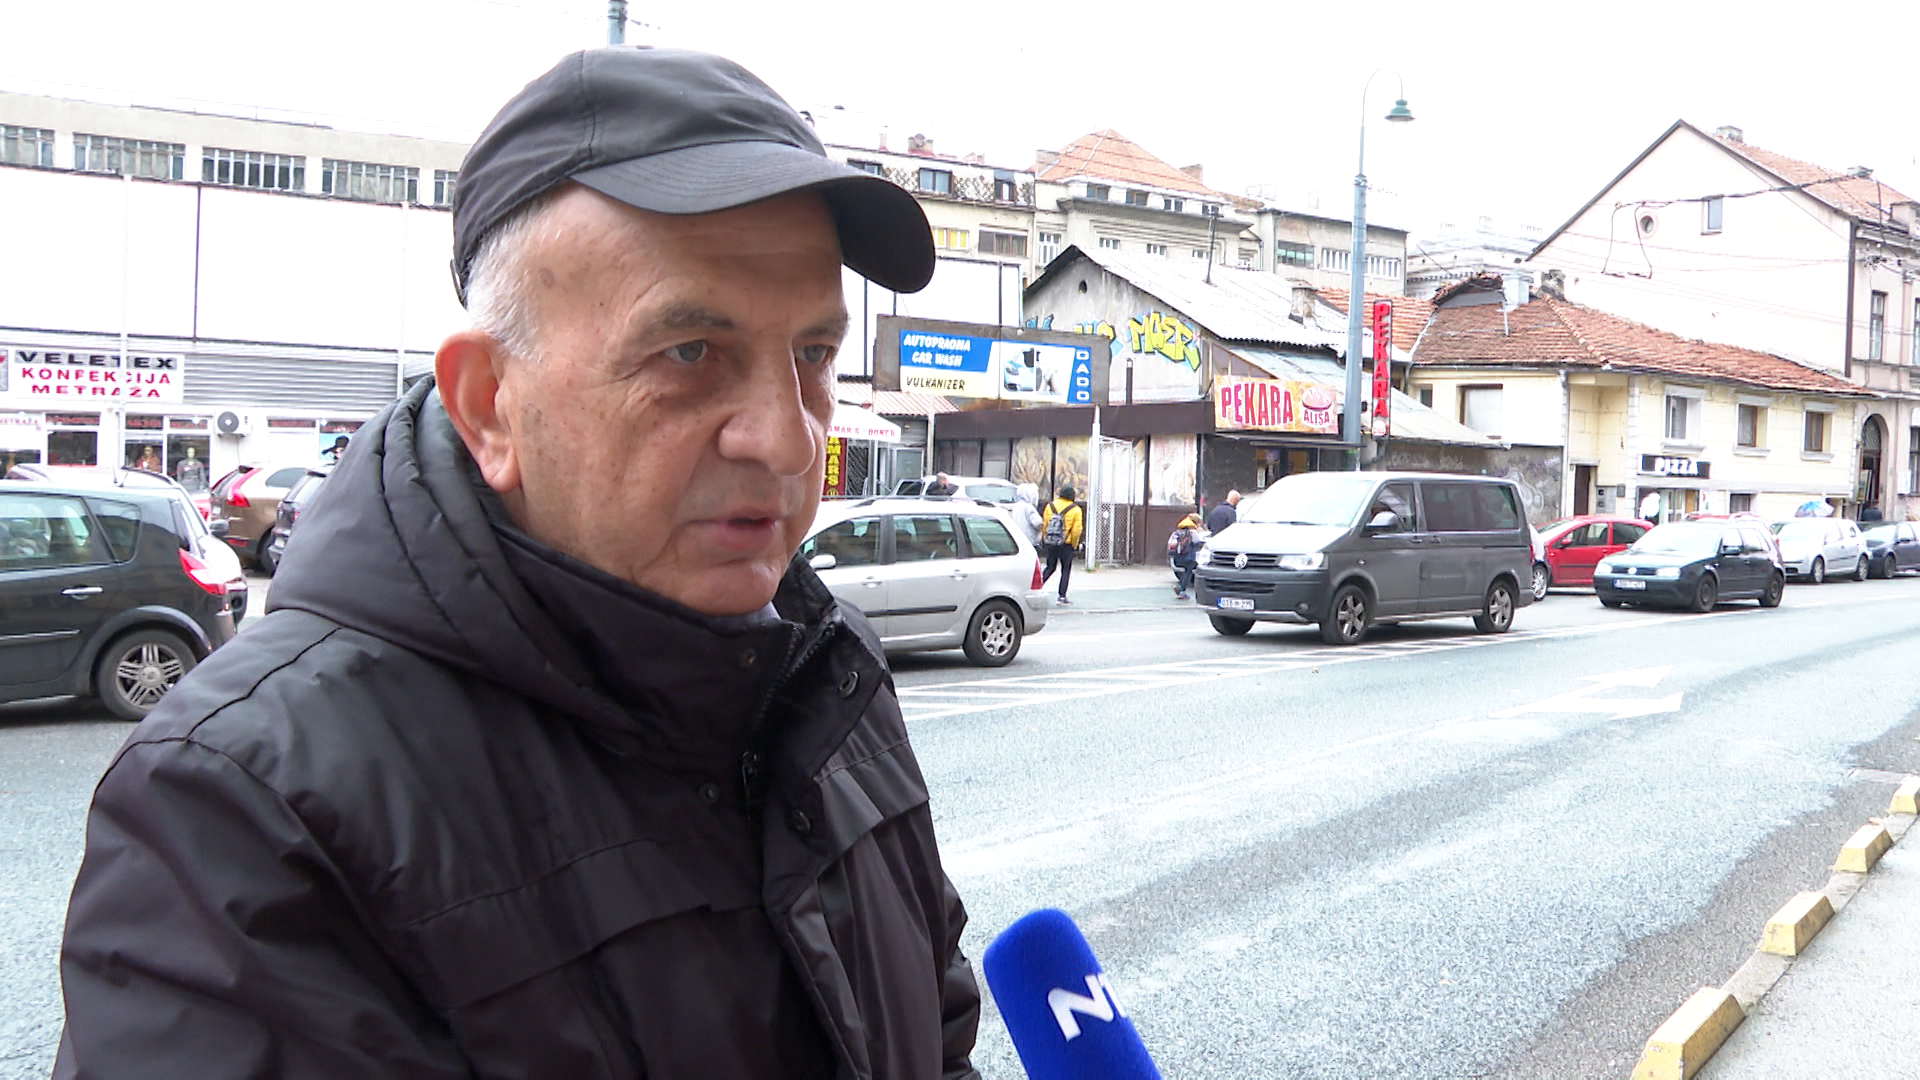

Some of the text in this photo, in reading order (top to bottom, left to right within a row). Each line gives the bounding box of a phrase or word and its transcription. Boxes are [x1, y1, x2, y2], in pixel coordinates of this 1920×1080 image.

[19, 351, 173, 369] VELETEX
[911, 351, 963, 368] CAR WASH
[1372, 303, 1390, 418] PEKARA
[906, 375, 966, 392] VULKANIZER
[1076, 350, 1090, 401] DADO
[1221, 381, 1293, 426] PEKARA
[1303, 409, 1330, 425] ALISA
[1655, 457, 1699, 475] PIZZA
